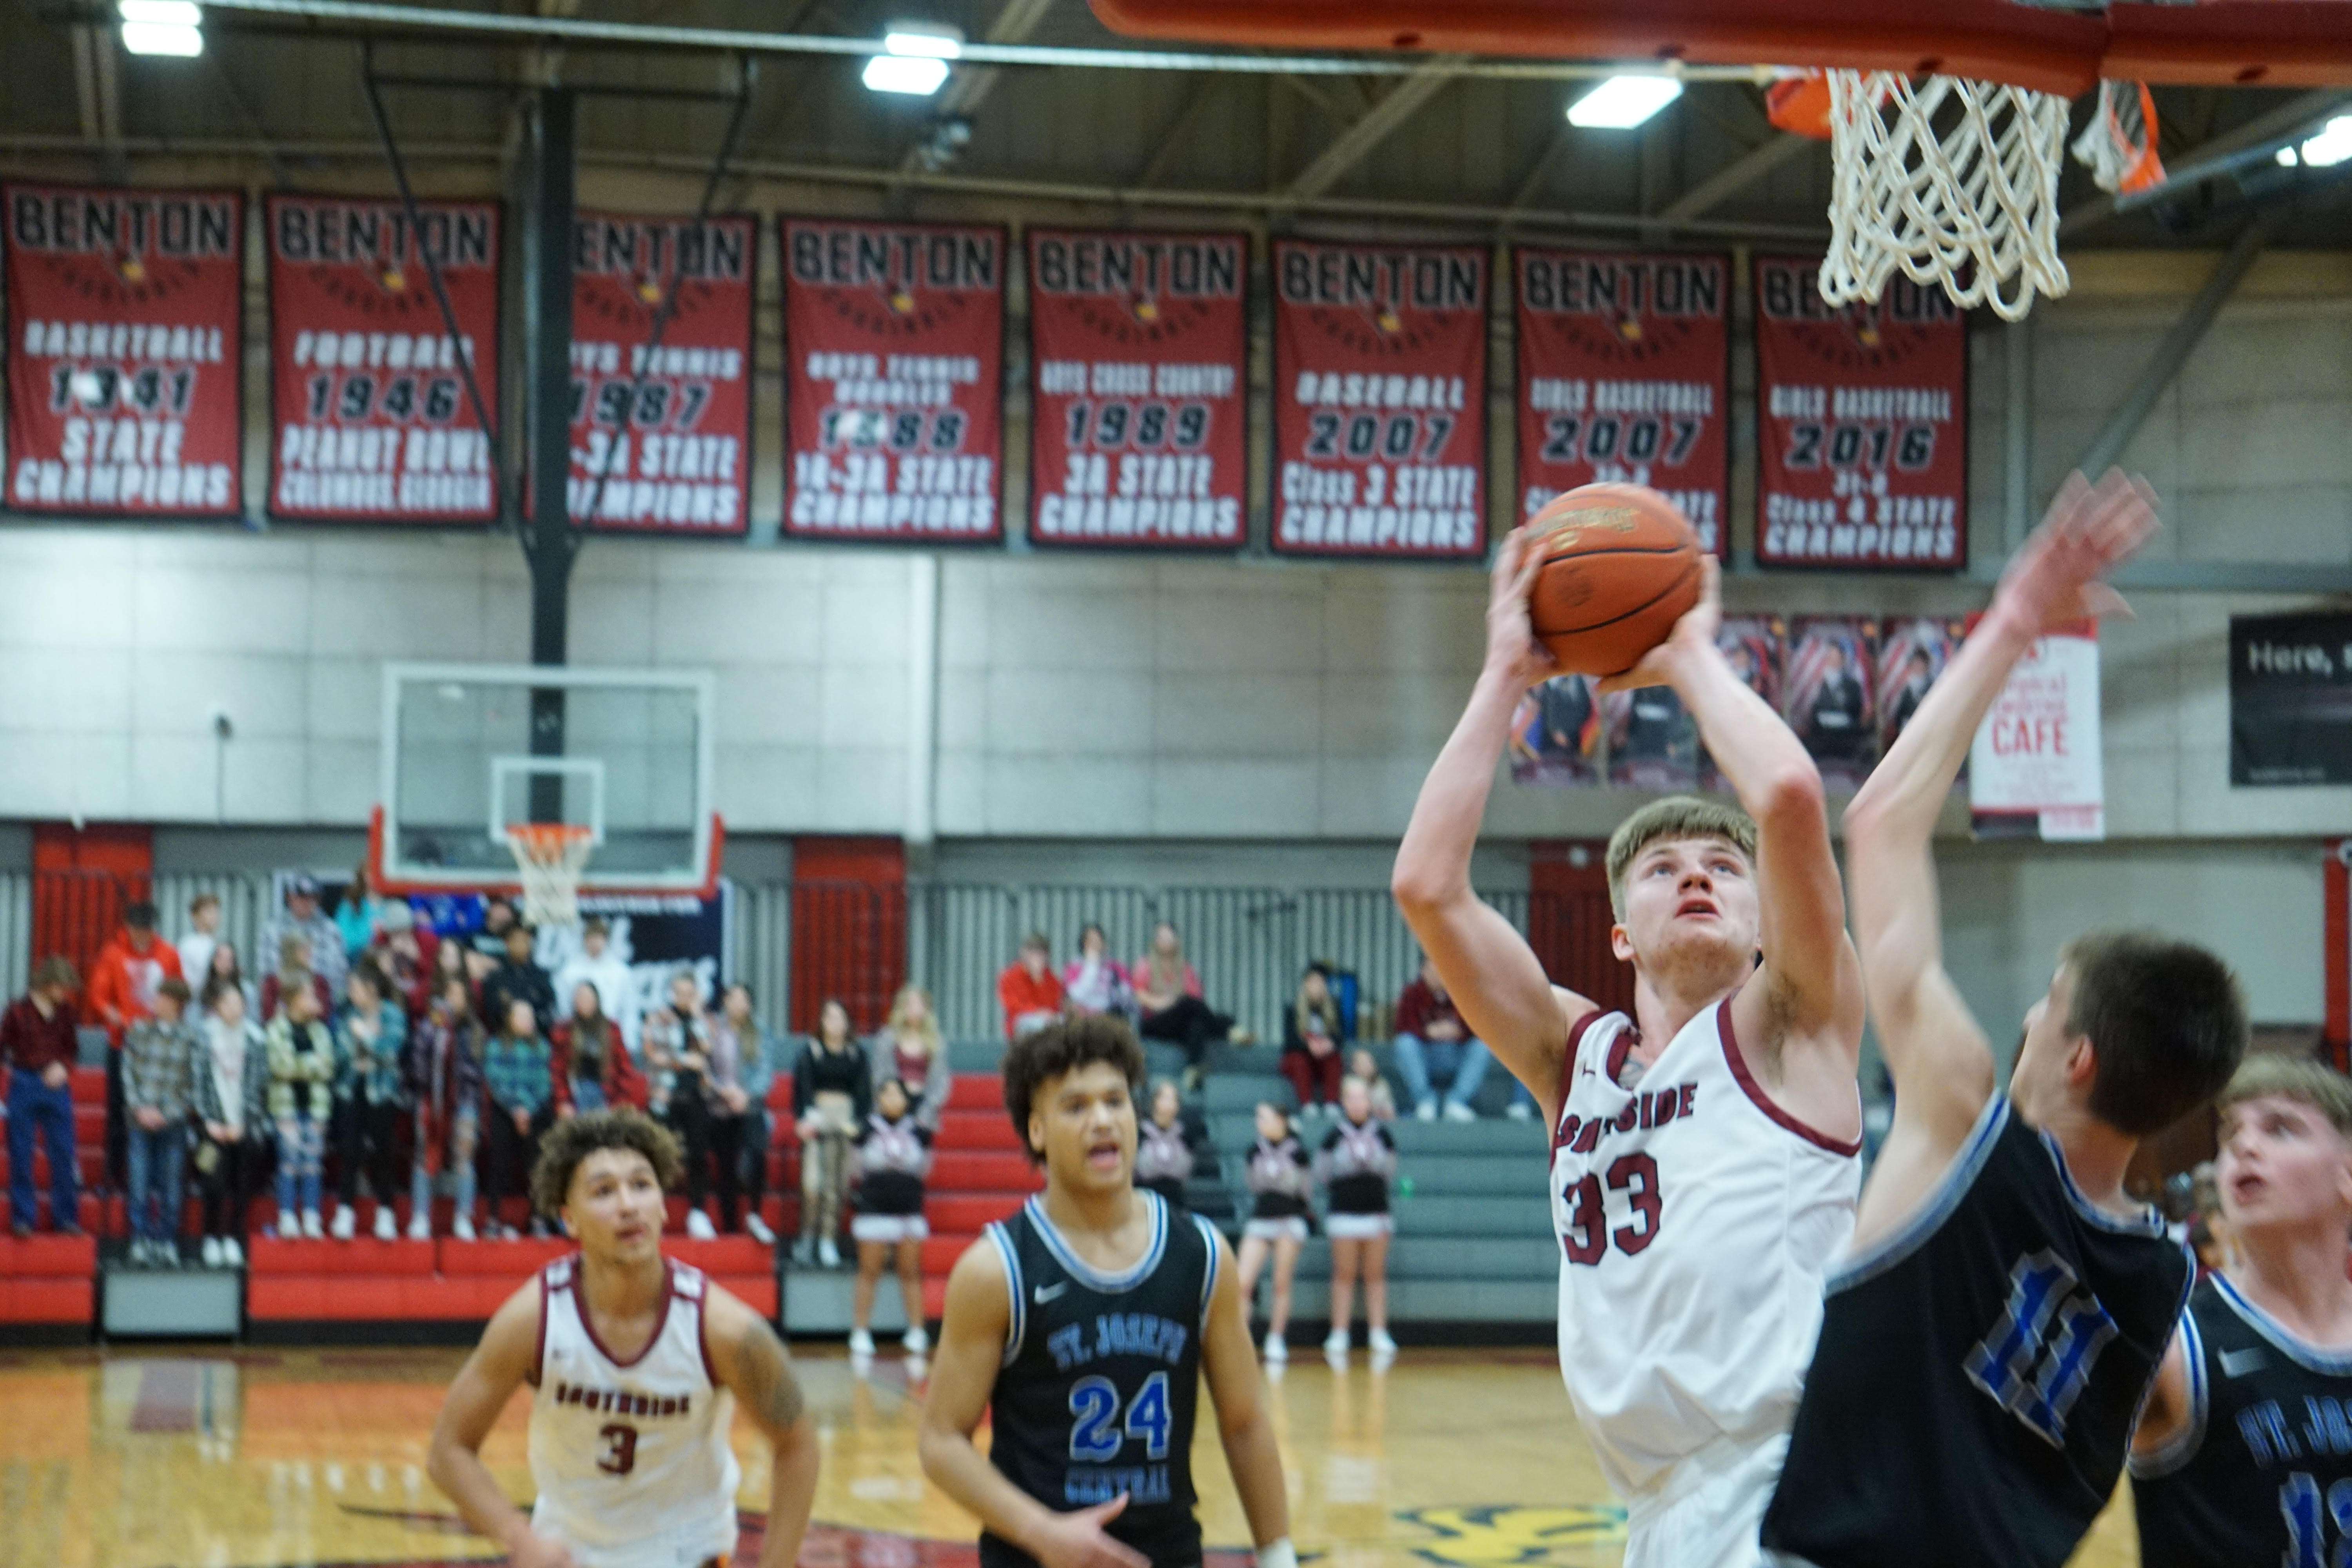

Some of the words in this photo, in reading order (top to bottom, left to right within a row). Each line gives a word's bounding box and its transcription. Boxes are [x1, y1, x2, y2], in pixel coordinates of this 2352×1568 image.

[11, 192, 232, 257] BENTON
[276, 203, 492, 266] BENTON
[572, 221, 747, 279] ENTON
[791, 229, 998, 289] BENTON
[1036, 239, 1239, 298] BENTON
[1279, 248, 1481, 309] BENTON
[1522, 257, 1722, 317] BENTON
[24, 319, 223, 363] BASKETBALL
[294, 329, 475, 370] FOOTBALL
[307, 371, 461, 425] 1946
[1295, 372, 1465, 411] BASEBALL
[63, 417, 185, 465] STATE
[1067, 402, 1210, 450] 1989
[1306, 414, 1454, 461] 2007
[1542, 414, 1703, 466] 2007
[1786, 423, 1936, 473] 2016
[15, 457, 231, 509] CHAMPIONS
[639, 434, 738, 482] STATE
[896, 456, 992, 495] STATE
[1064, 453, 1109, 496] 3A
[1118, 455, 1213, 498] STATE
[1394, 465, 1477, 507] STATE
[1876, 497, 1956, 526] STATE
[789, 492, 995, 532] CHAMPIONS
[1038, 494, 1240, 539] CHAMPIONS
[1281, 505, 1478, 549] CHAMPIONS
[1764, 522, 1957, 559] CHAMPIONS
[1563, 1151, 1662, 1266] 33
[1096, 1312, 1188, 1367] JOSEPH
[1963, 1247, 2118, 1450] 11
[1069, 1371, 1173, 1463] 24
[2303, 1395, 2352, 1455] JO
[596, 1422, 638, 1477] 3
